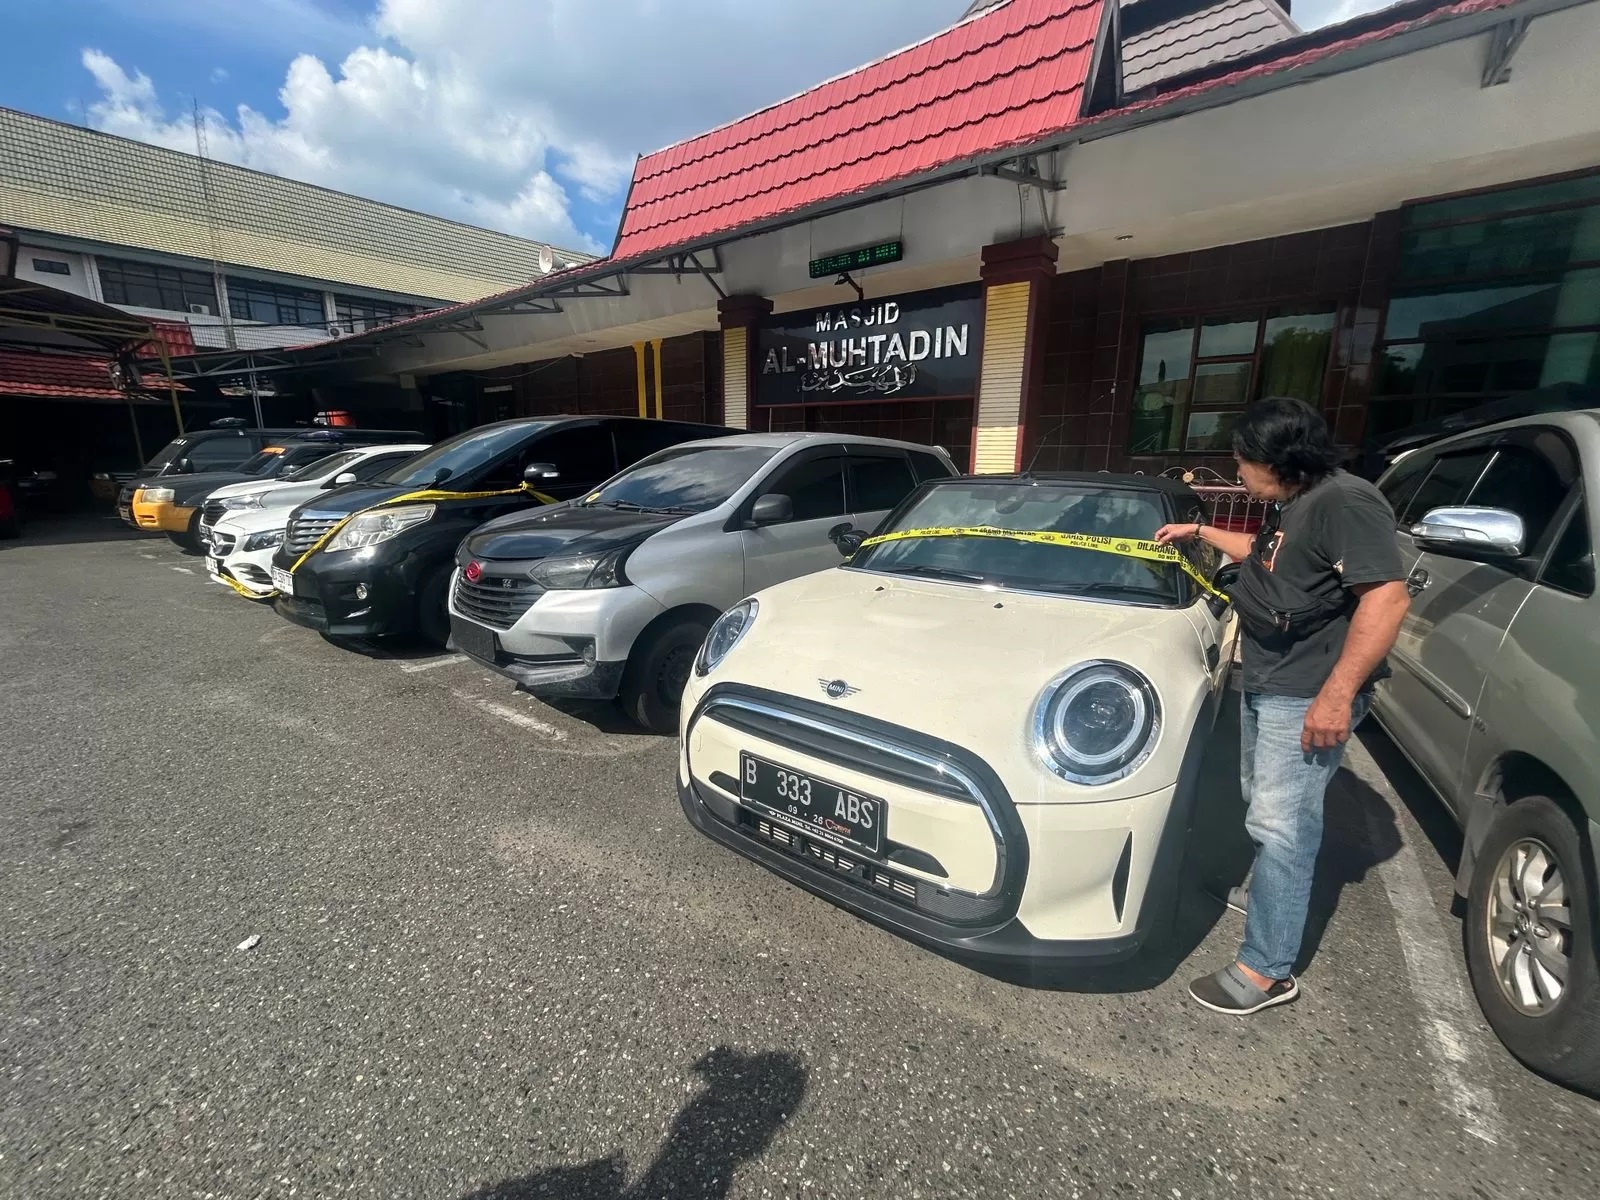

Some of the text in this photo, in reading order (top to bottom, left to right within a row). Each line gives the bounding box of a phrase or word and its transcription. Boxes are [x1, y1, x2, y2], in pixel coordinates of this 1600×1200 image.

[815, 302, 899, 332] MASJID
[762, 323, 969, 375] AL-MUHTADIN
[1086, 535, 1112, 545] POLISI
[1137, 541, 1176, 555] DILARANG
[746, 758, 757, 785] B
[777, 771, 812, 806] 333
[834, 791, 874, 829] ABS
[776, 813, 791, 822] PLAZA
[787, 804, 824, 825] 09 26
